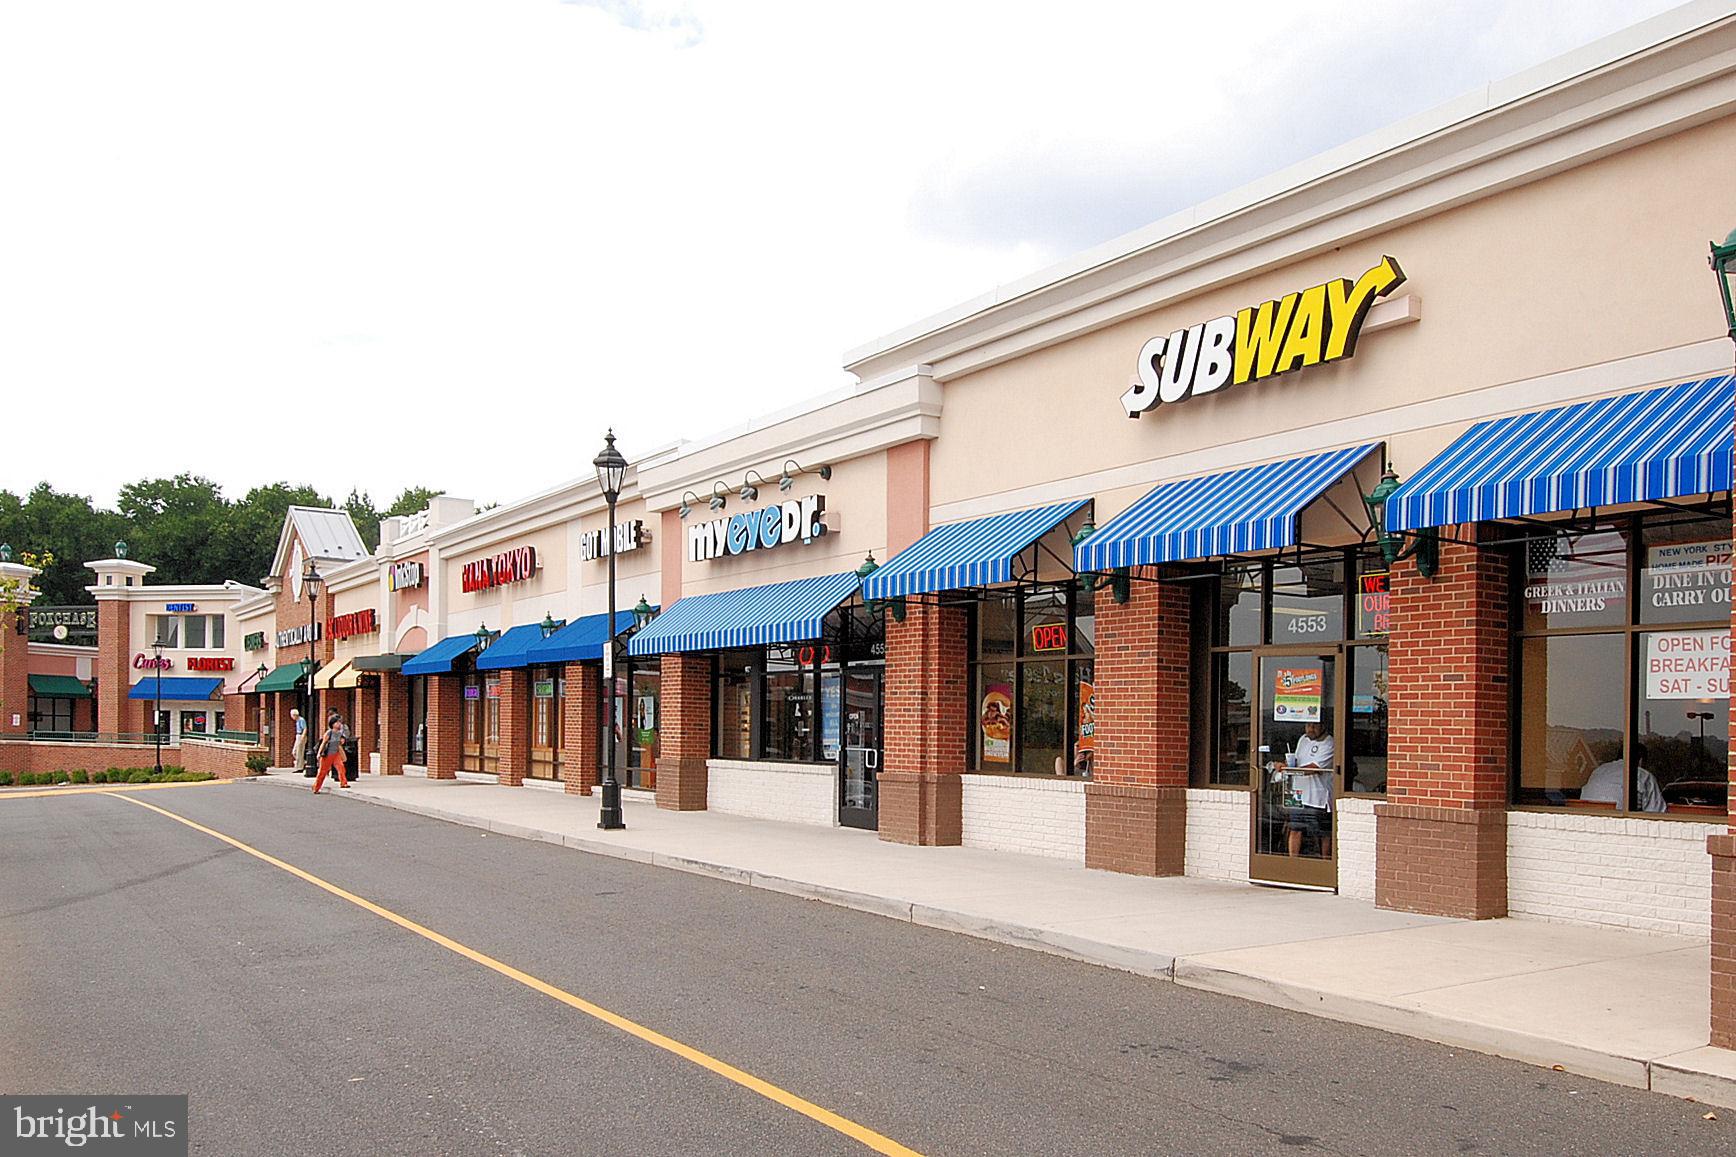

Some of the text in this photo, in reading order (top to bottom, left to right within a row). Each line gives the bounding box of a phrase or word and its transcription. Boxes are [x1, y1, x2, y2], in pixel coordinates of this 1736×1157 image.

[1120, 254, 1405, 418] SUBWAY
[580, 530, 598, 561] GOT
[1659, 542, 1733, 558] NEW YORK STY
[491, 546, 532, 586] TOKYO
[1651, 553, 1733, 571] HOME MADE PIZ
[1363, 575, 1386, 593] WE
[1653, 569, 1732, 590] DINE IN O
[1524, 580, 1625, 599] GREEK & ITALIAN
[1652, 587, 1732, 607] CARRY OU
[1541, 596, 1606, 614] DINNERS
[29, 611, 97, 629] FOXCHASE
[1287, 615, 1327, 634] 4553
[870, 643, 885, 655] 455
[1658, 635, 1731, 653] OPEN FO
[187, 657, 234, 671] FLORIST
[1650, 656, 1730, 673] BREAKFA
[1659, 678, 1691, 694] SAT
[1707, 677, 1730, 693] SU
